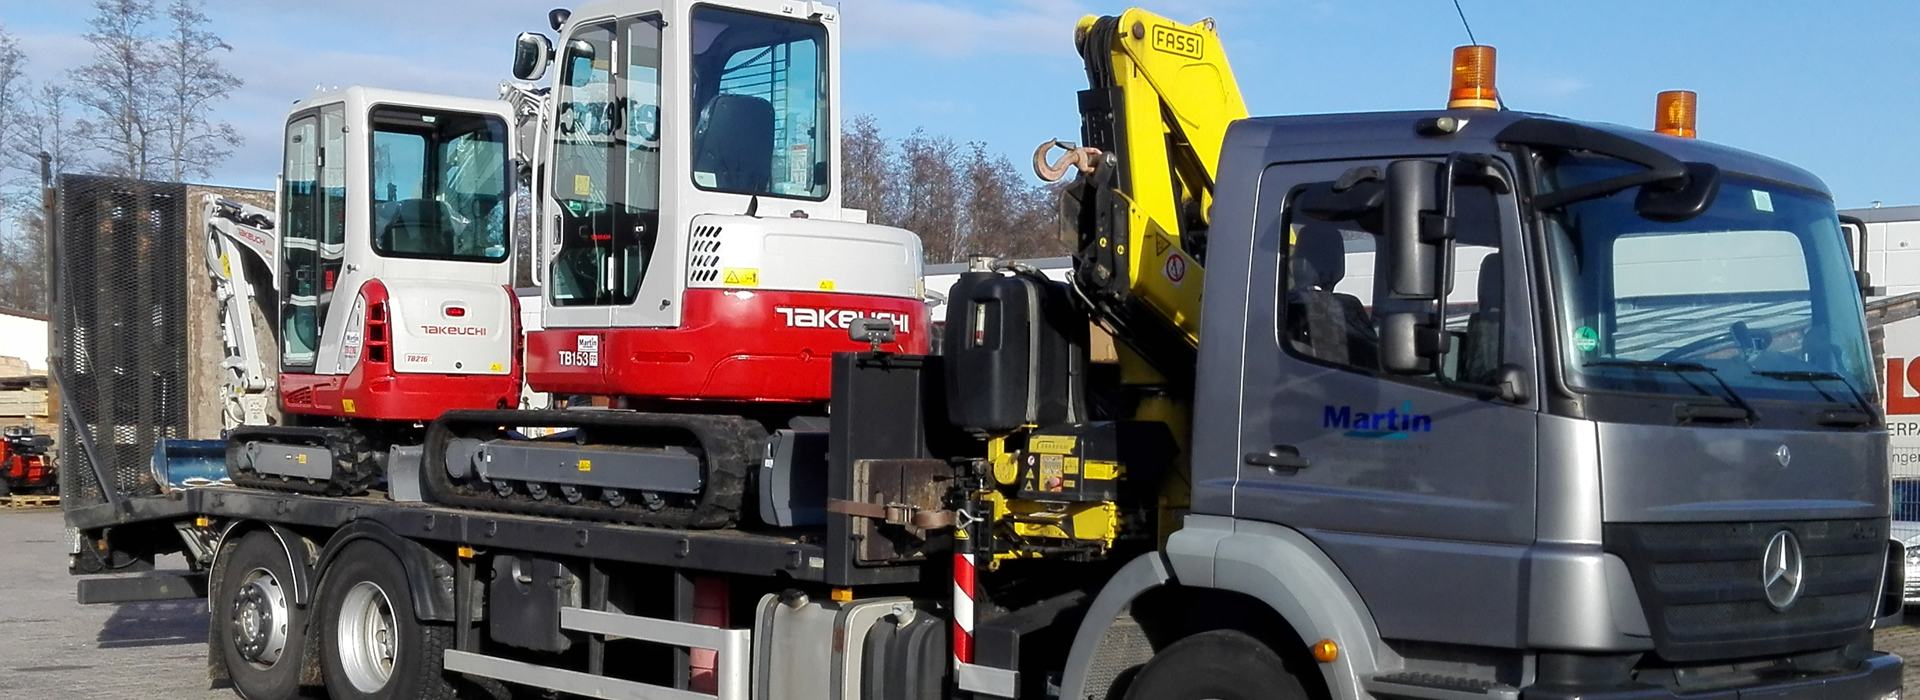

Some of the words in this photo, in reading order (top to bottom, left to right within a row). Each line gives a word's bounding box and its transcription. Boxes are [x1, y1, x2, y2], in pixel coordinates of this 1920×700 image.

[1157, 30, 1199, 54] FASSI
[421, 325, 487, 336] TAKEUCHI
[558, 351, 589, 366] TB153
[1323, 400, 1432, 432] Martin
